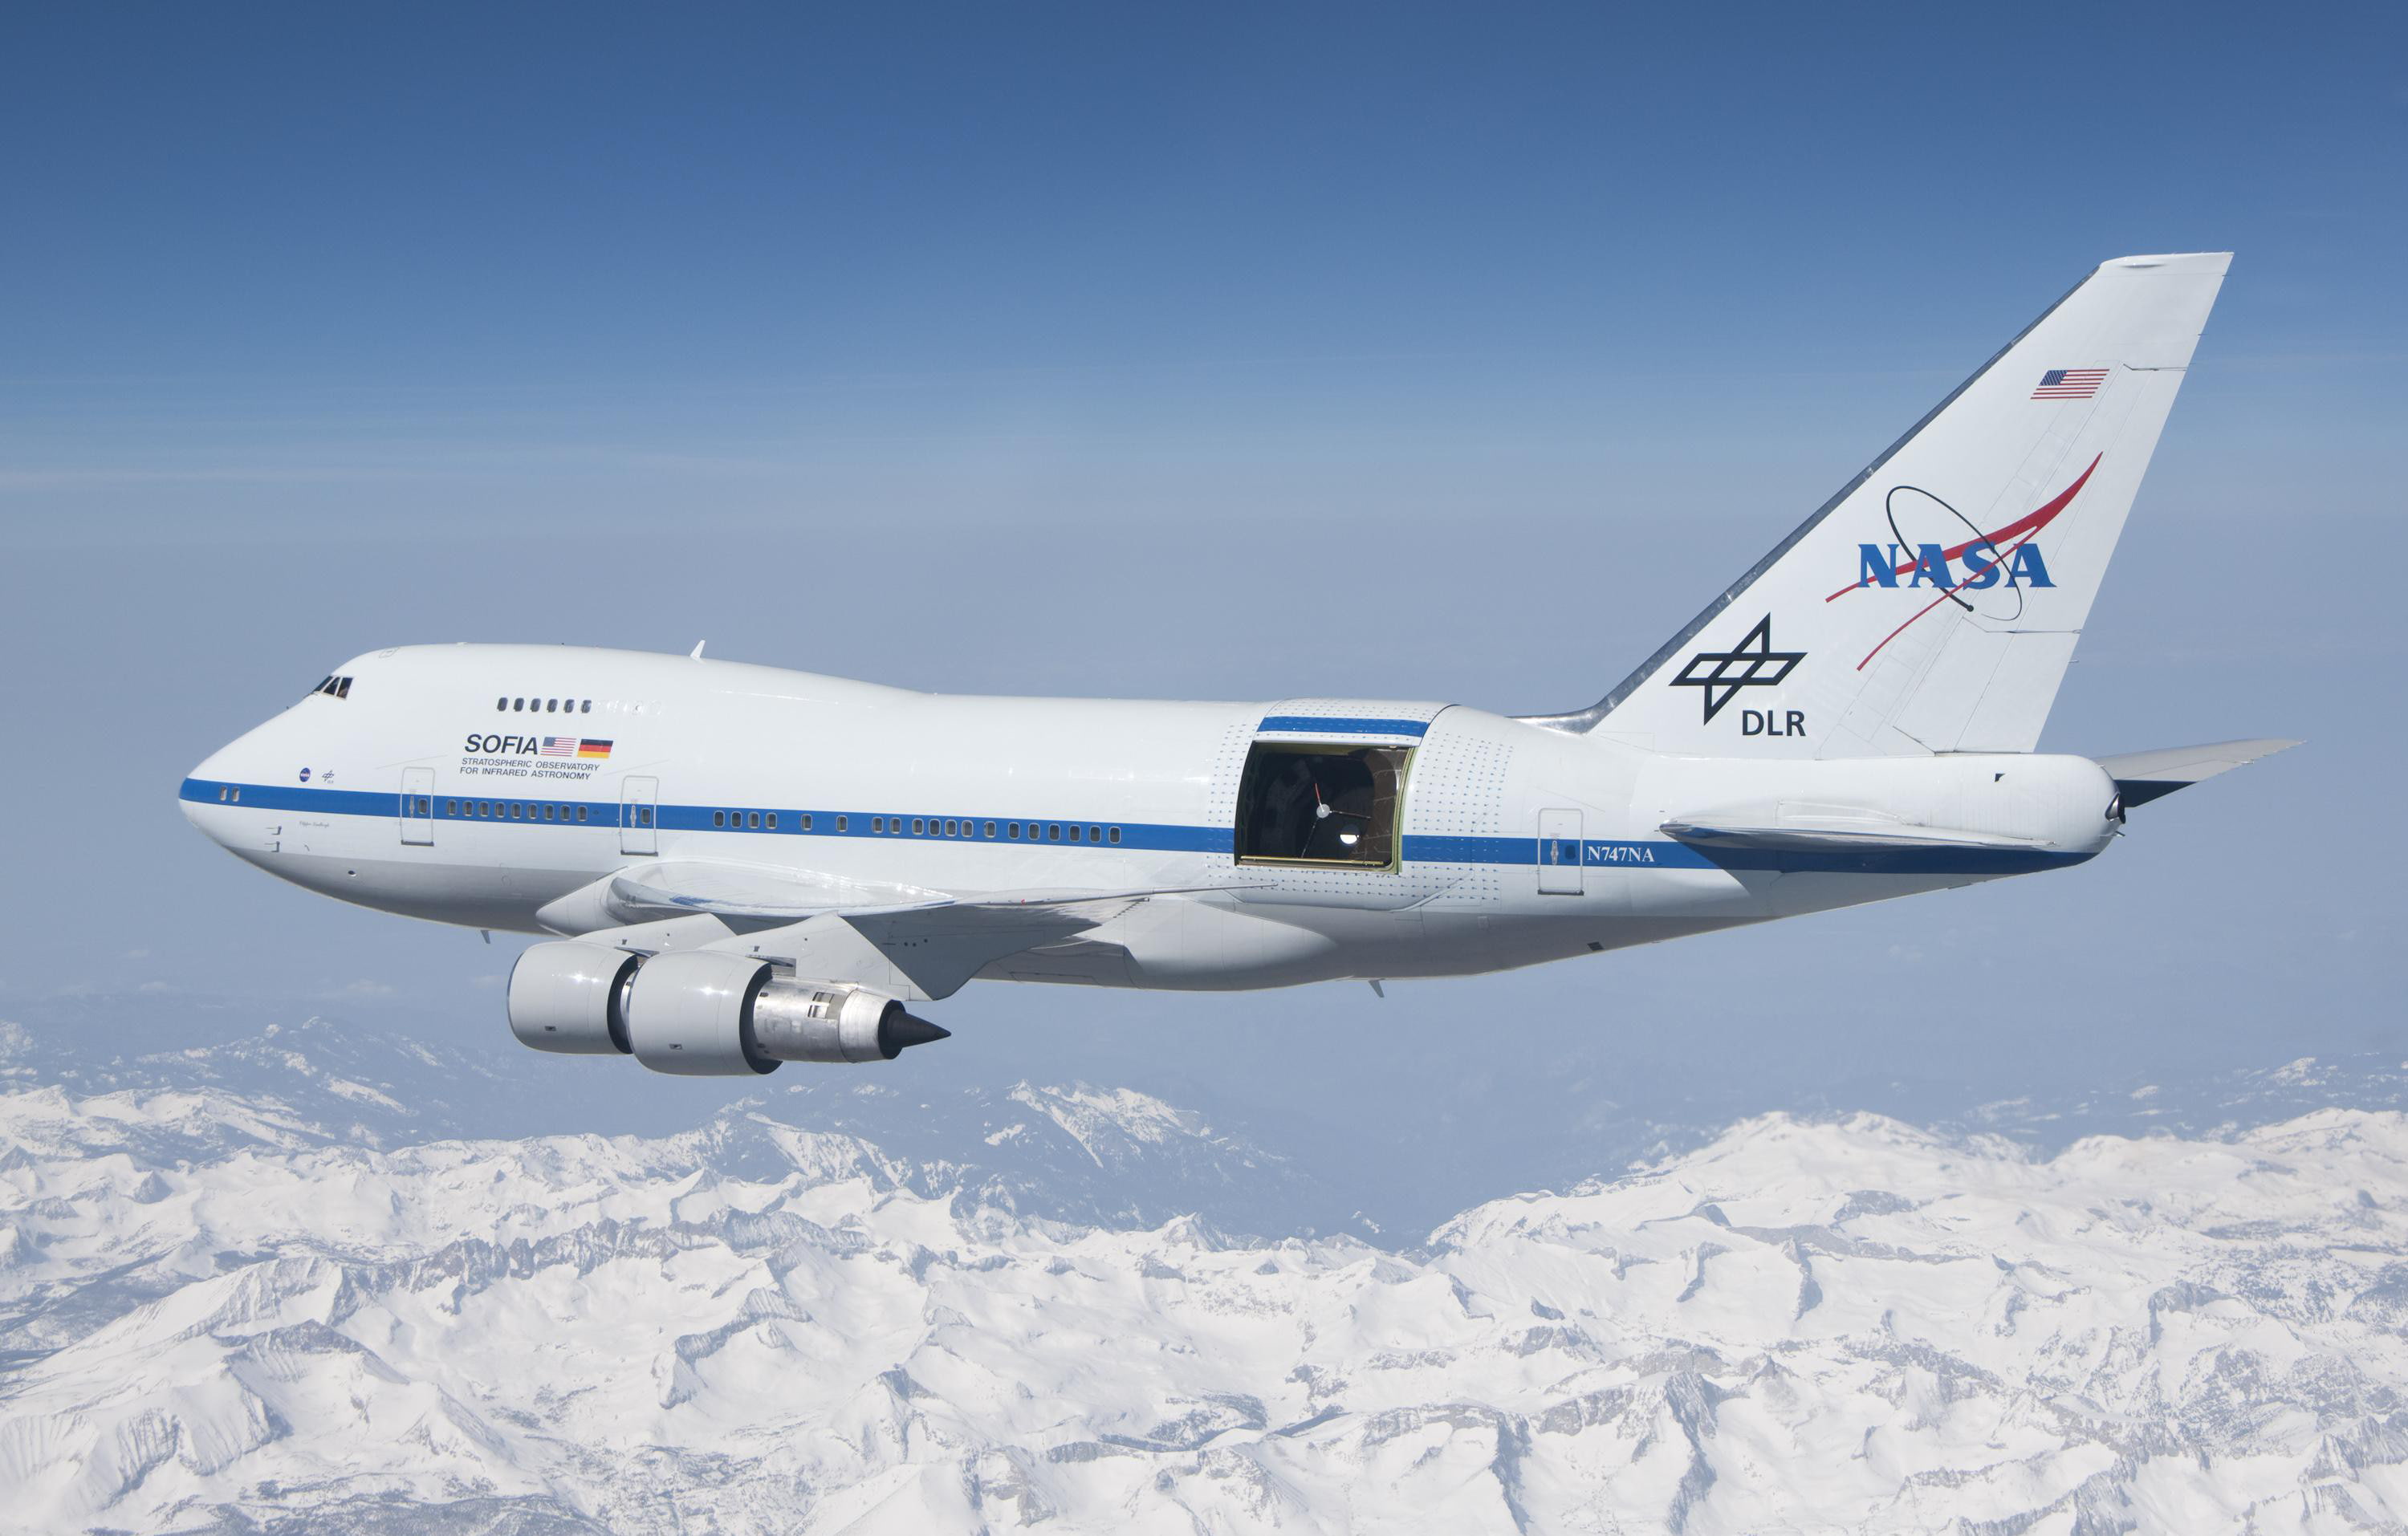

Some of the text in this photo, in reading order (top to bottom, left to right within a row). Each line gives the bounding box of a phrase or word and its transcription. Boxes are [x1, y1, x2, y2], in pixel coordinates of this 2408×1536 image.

[1857, 541, 2057, 591] NASA
[1742, 709, 1807, 737] DLR
[465, 734, 539, 755] SOFIA
[460, 766, 591, 780] FOR INFRARED ASTRONOMY
[462, 758, 600, 771] STRATOSPHERIC OBSERVATORY
[1587, 846, 1655, 863] N747NA
